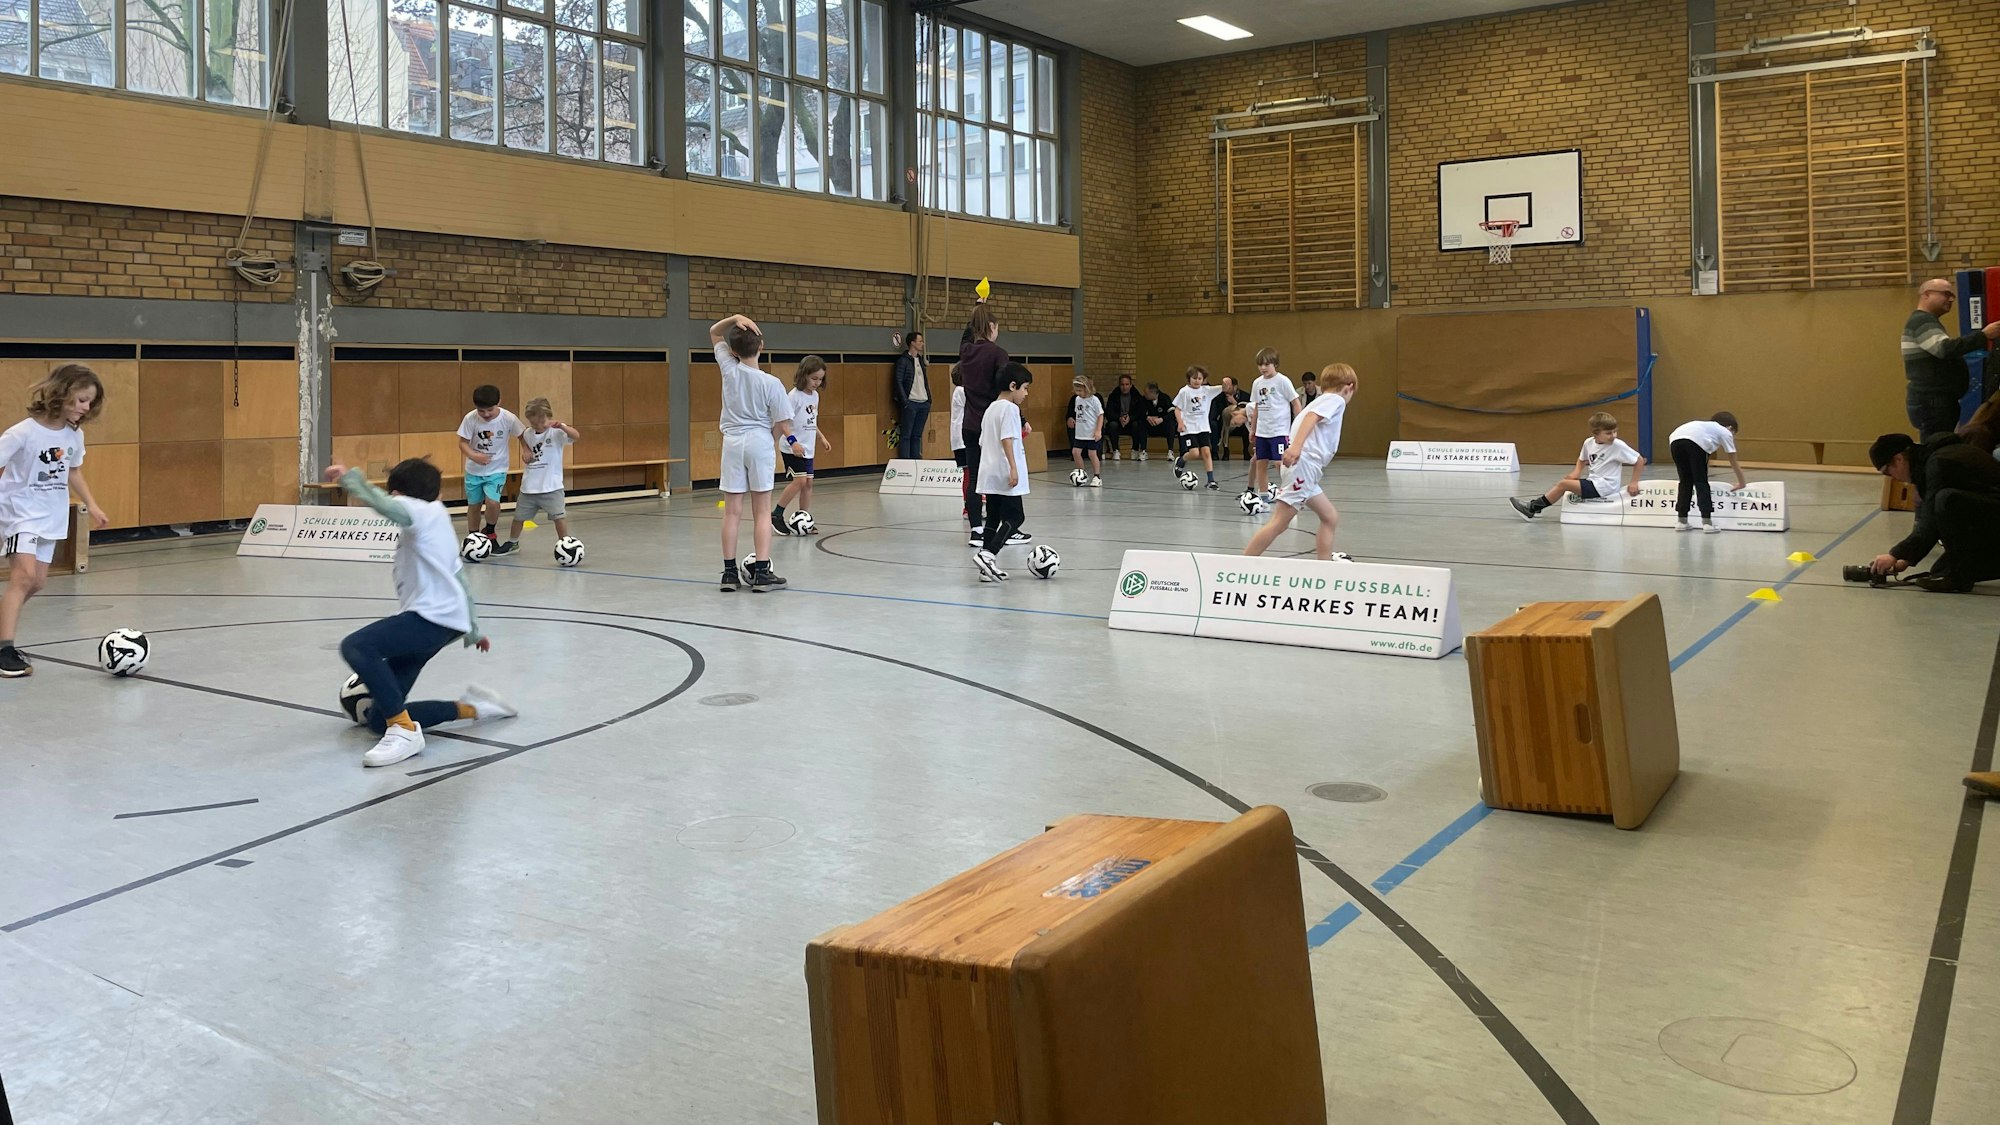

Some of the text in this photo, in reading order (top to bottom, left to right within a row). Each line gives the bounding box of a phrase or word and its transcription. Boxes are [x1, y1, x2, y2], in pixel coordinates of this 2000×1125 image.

[1631, 499, 1654, 508] EIN
[1731, 502, 1778, 511] TEAM!
[303, 517, 337, 526] SCHULE
[340, 518, 359, 526] UND
[297, 529, 399, 542] EIN STARKES TEA
[1215, 571, 1431, 598] SCHULE UND FUSSBALL:
[1212, 591, 1439, 623] EIN STARKES TEAM!
[1370, 638, 1433, 653] www.dfb.de
